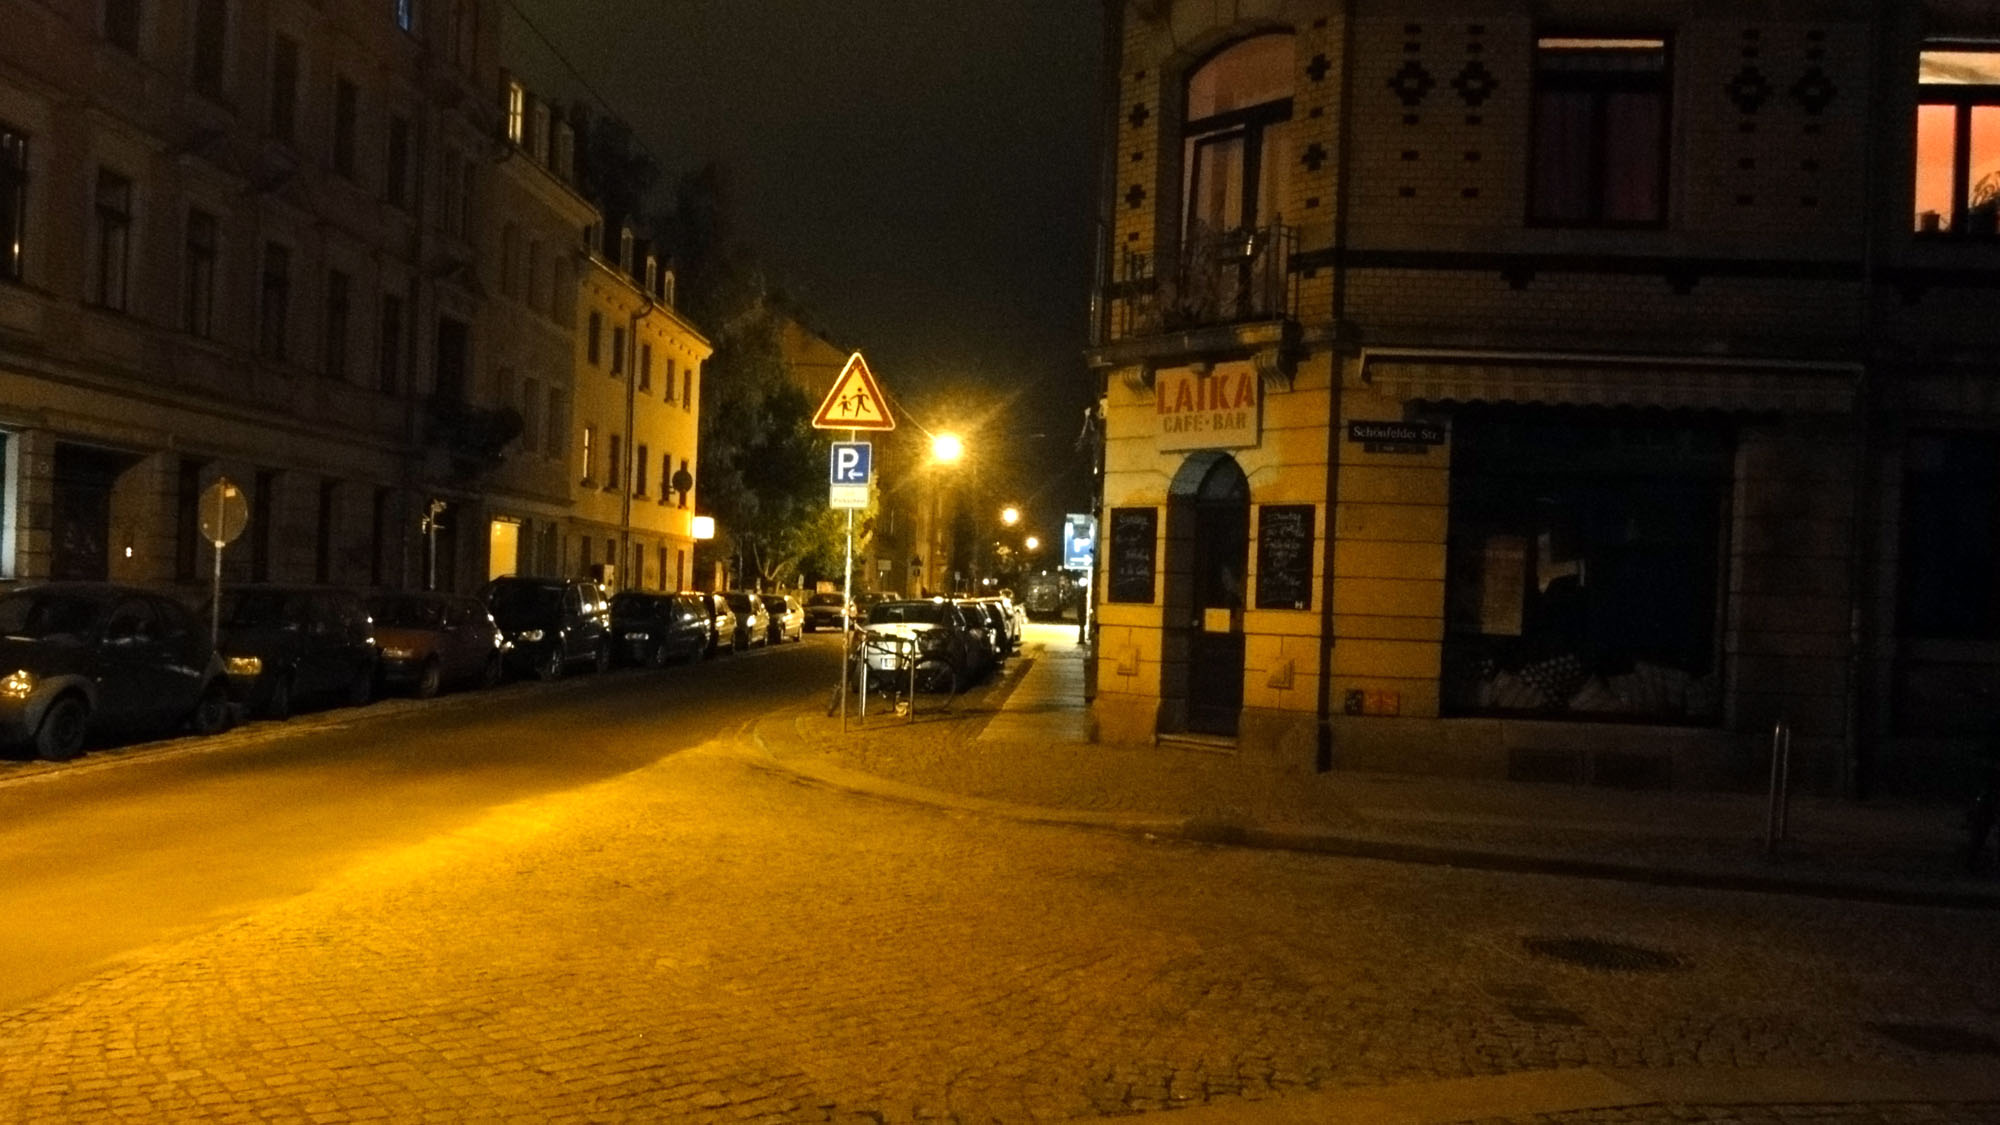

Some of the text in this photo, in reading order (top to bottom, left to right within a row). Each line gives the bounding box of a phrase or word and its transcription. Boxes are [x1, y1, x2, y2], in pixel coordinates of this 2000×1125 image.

[1157, 372, 1255, 415] LAIKA
[1421, 428, 1440, 440] Str.
[838, 448, 859, 480] P
